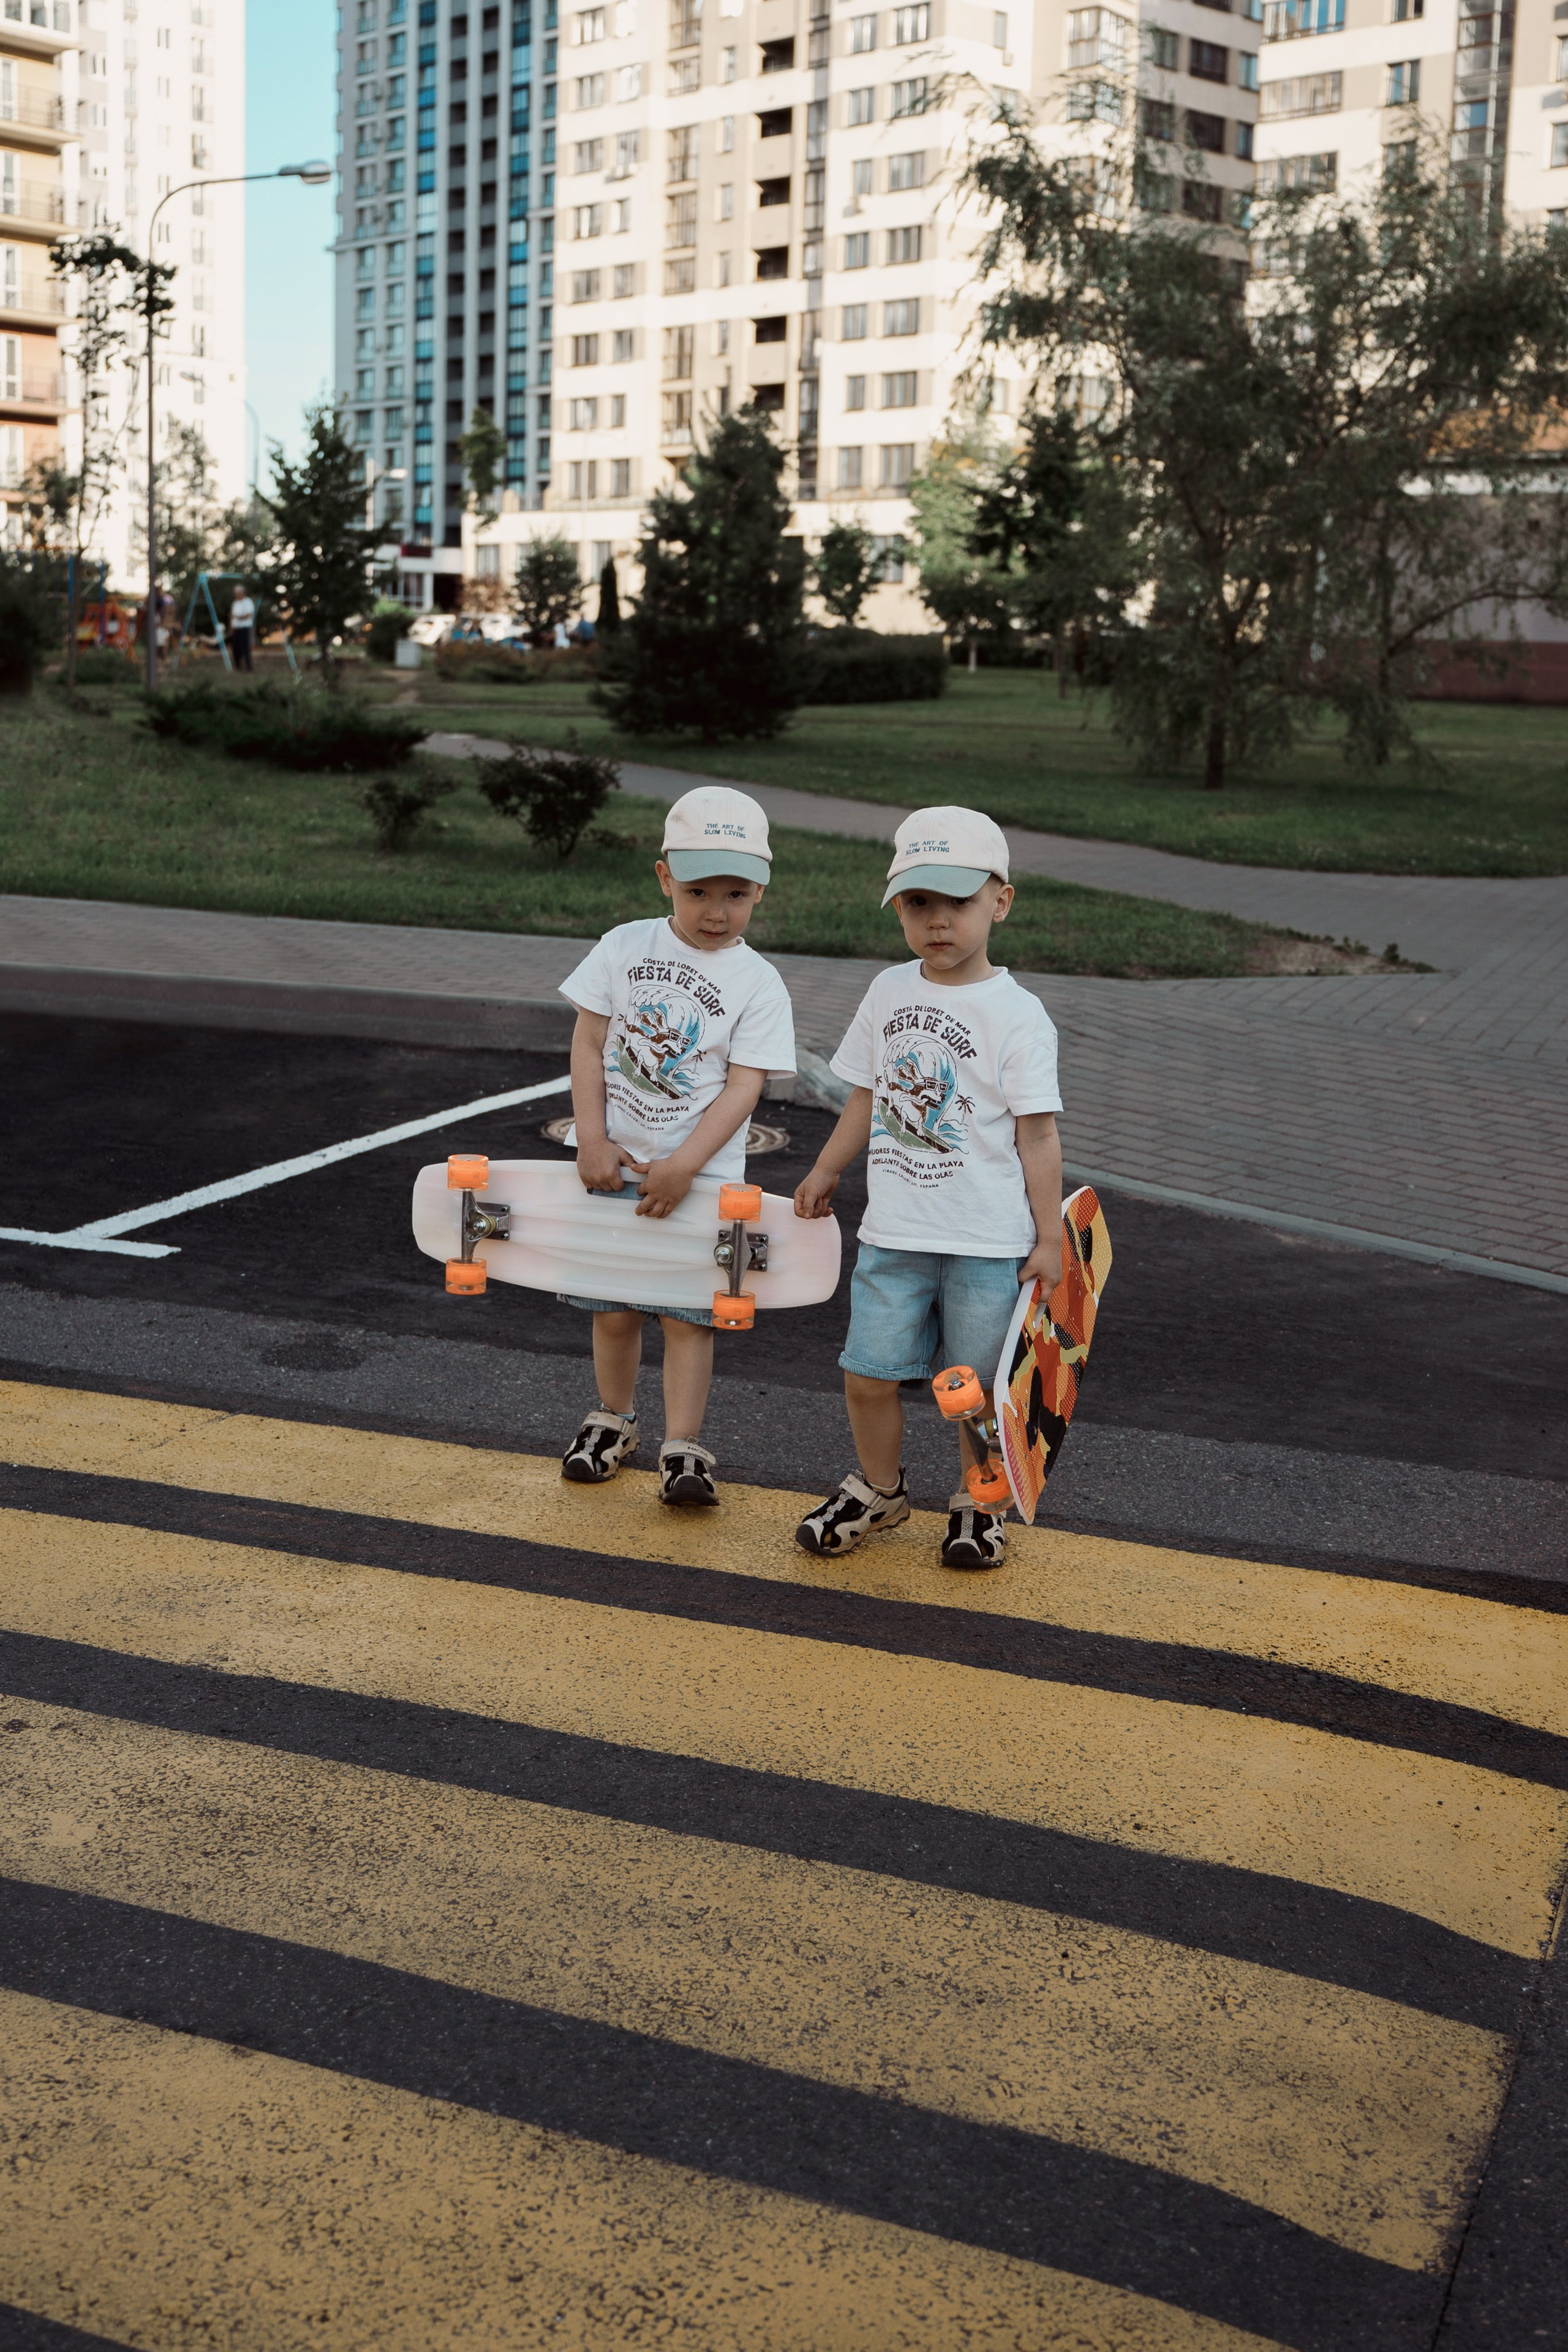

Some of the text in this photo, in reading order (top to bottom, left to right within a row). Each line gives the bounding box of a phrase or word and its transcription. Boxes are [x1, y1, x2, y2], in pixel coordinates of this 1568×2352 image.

[724, 830, 746, 839] LIVING
[905, 847, 920, 856] SLOW
[677, 962, 699, 976] LORET
[698, 974, 707, 982] DE
[707, 982, 722, 995] MAR
[627, 965, 726, 1017] FIESTA DE SURF
[894, 1005, 913, 1016] COSTA
[924, 1006, 945, 1016] LORET
[944, 1014, 956, 1023] DE
[954, 1021, 971, 1036] MAR
[883, 1013, 978, 1060] FIESTA DE SURF
[622, 1087, 644, 1106] FIESTAS
[628, 1102, 647, 1120] SOBRE
[892, 1148, 913, 1164] FIESTAS
[872, 1158, 900, 1167] ADELANTE
[899, 1163, 918, 1178] SOBRE
[934, 1170, 954, 1180] OLAS
